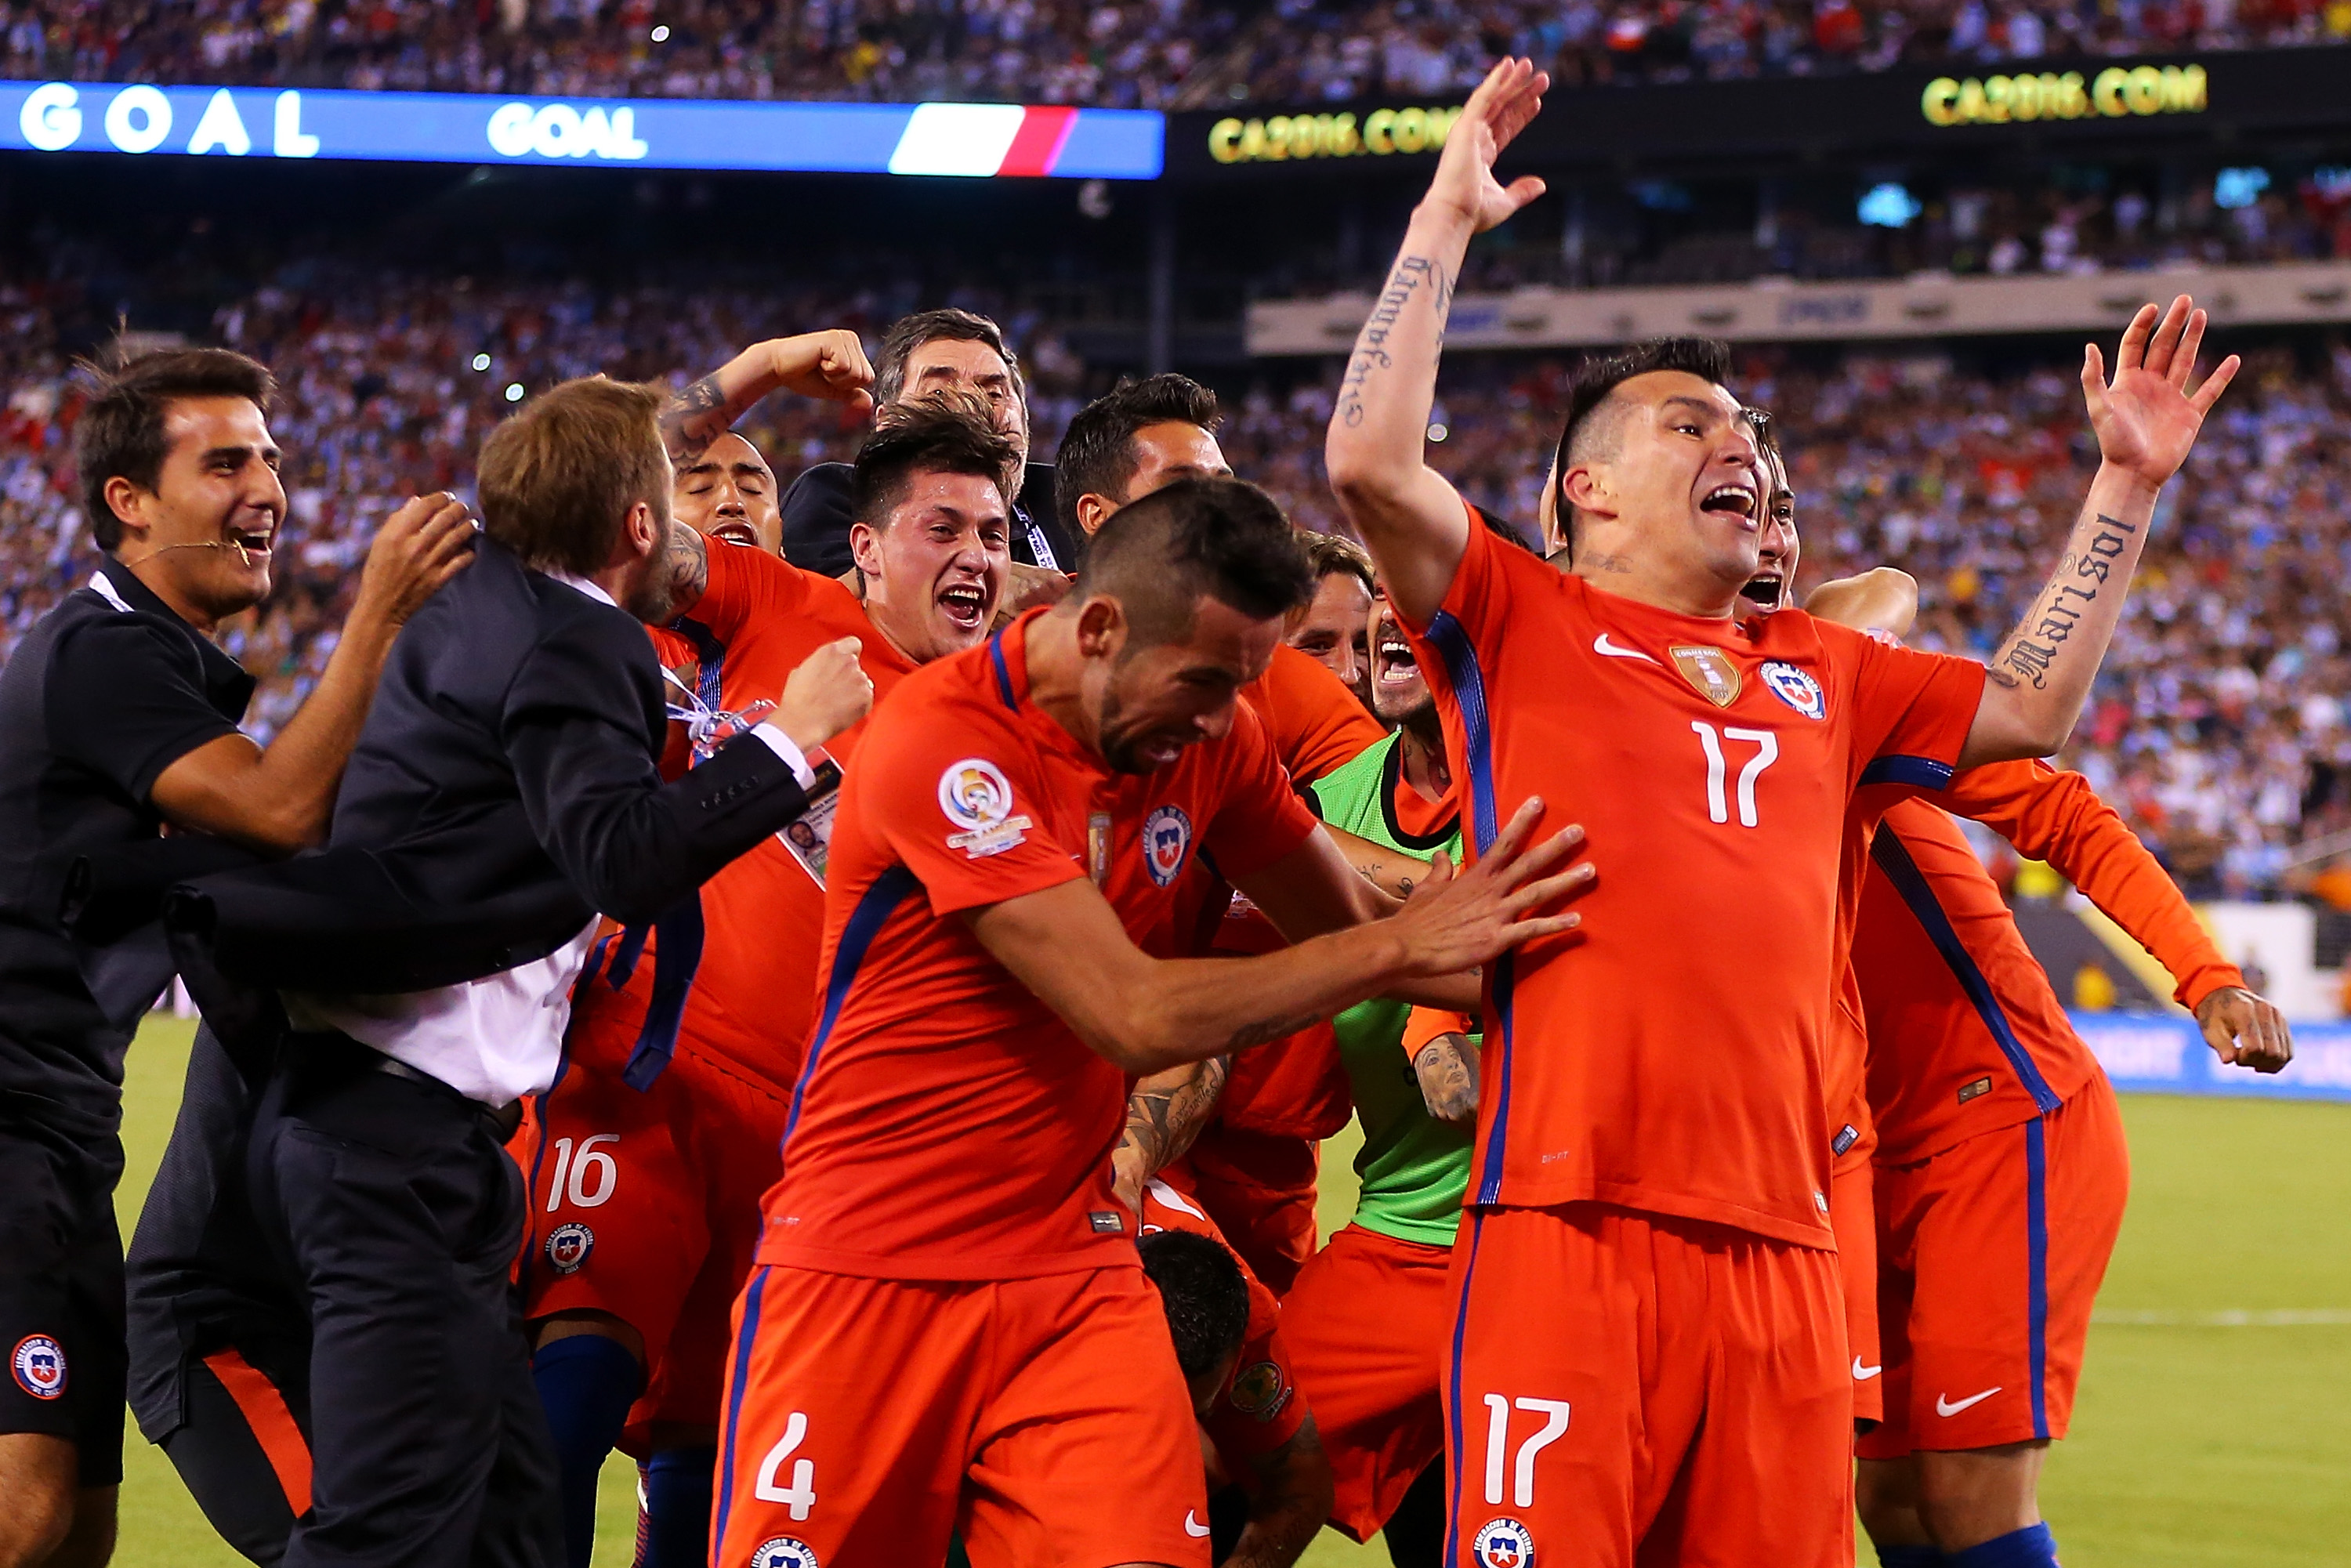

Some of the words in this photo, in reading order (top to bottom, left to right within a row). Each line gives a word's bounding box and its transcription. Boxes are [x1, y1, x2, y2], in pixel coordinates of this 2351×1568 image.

[19, 82, 321, 158] GOAL
[487, 102, 649, 160] GOAL
[2003, 512, 2136, 690] Marisol
[1690, 720, 1779, 827] 17
[547, 1134, 621, 1212] 16
[755, 1412, 817, 1521] 4
[1483, 1392, 1570, 1508] 17
